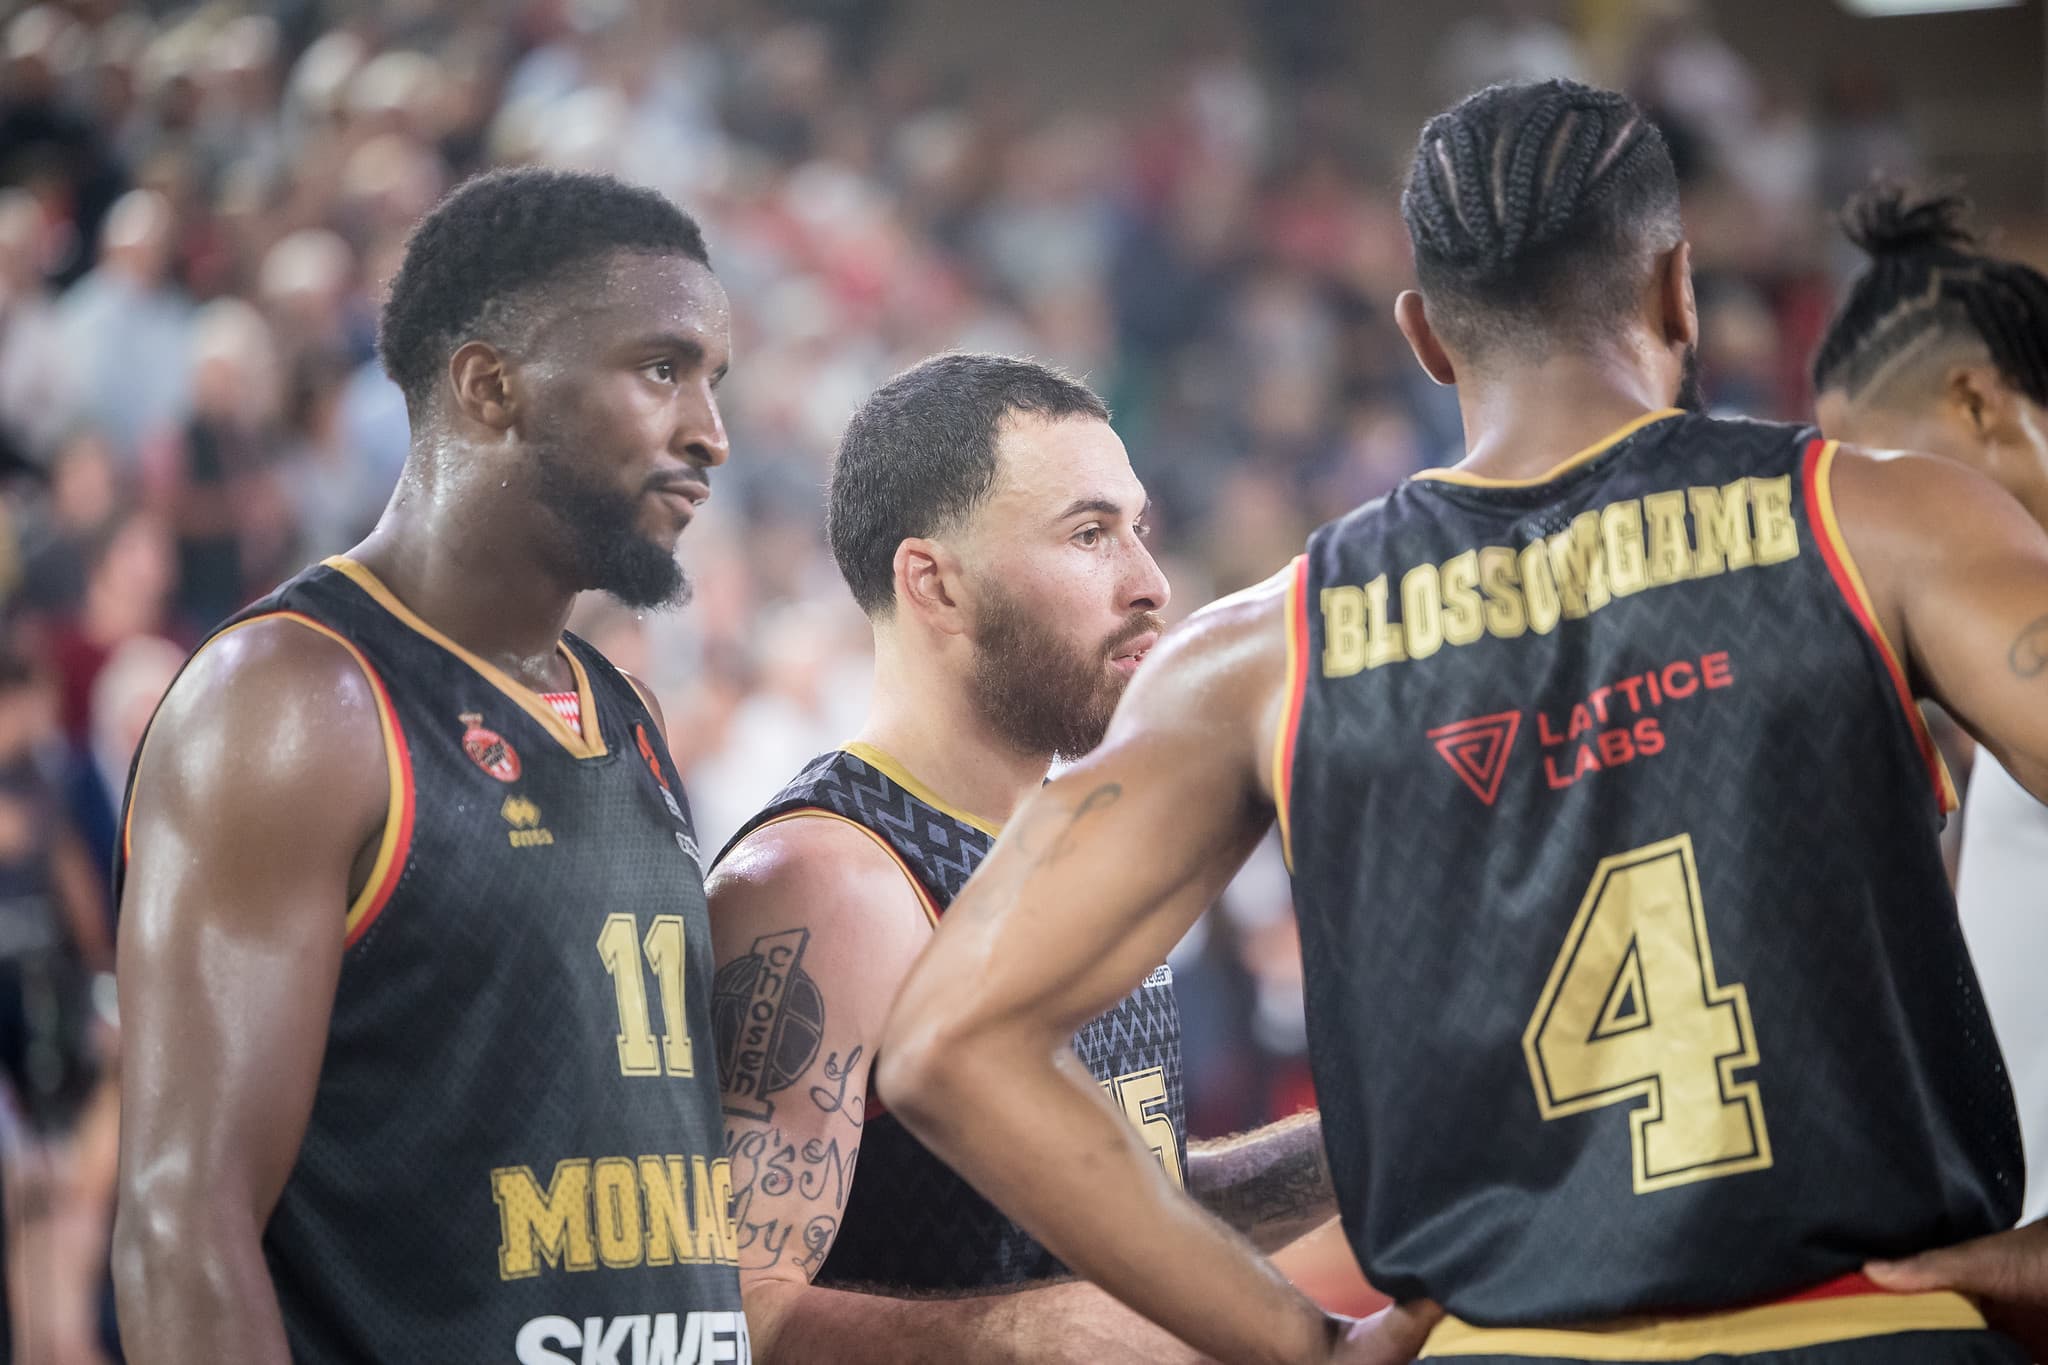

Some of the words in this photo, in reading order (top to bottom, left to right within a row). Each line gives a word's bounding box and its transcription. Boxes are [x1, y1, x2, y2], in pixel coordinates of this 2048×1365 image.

[1321, 474, 1799, 678] BLOSSOMGAME
[1538, 651, 1735, 747] LATTICE
[1543, 718, 1667, 791] LABS
[597, 912, 695, 1078] 11
[1522, 832, 1773, 1195] 4
